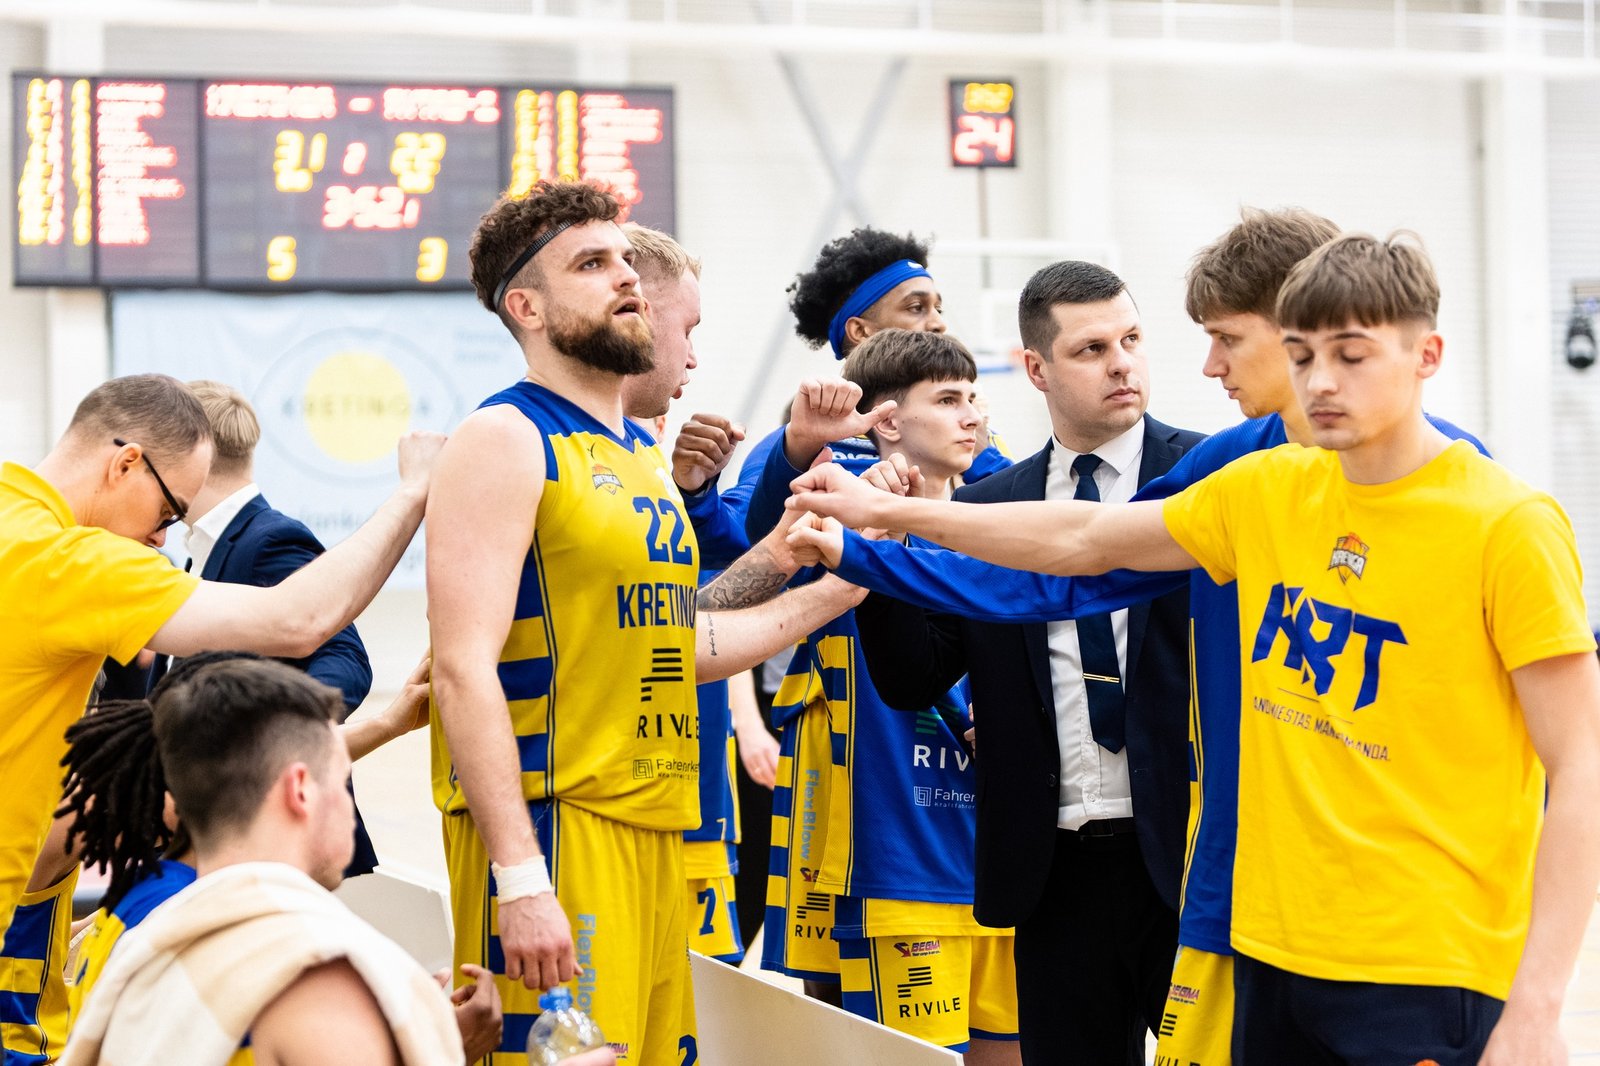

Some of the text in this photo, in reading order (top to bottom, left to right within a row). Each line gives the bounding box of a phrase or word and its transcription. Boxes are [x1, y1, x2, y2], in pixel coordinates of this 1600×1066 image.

[952, 114, 1016, 165] 24
[632, 496, 693, 567] 22
[800, 769, 819, 861] FlexBlow
[934, 788, 976, 802] Fahrer
[697, 887, 716, 936] 7
[899, 997, 961, 1018] RIVILE
